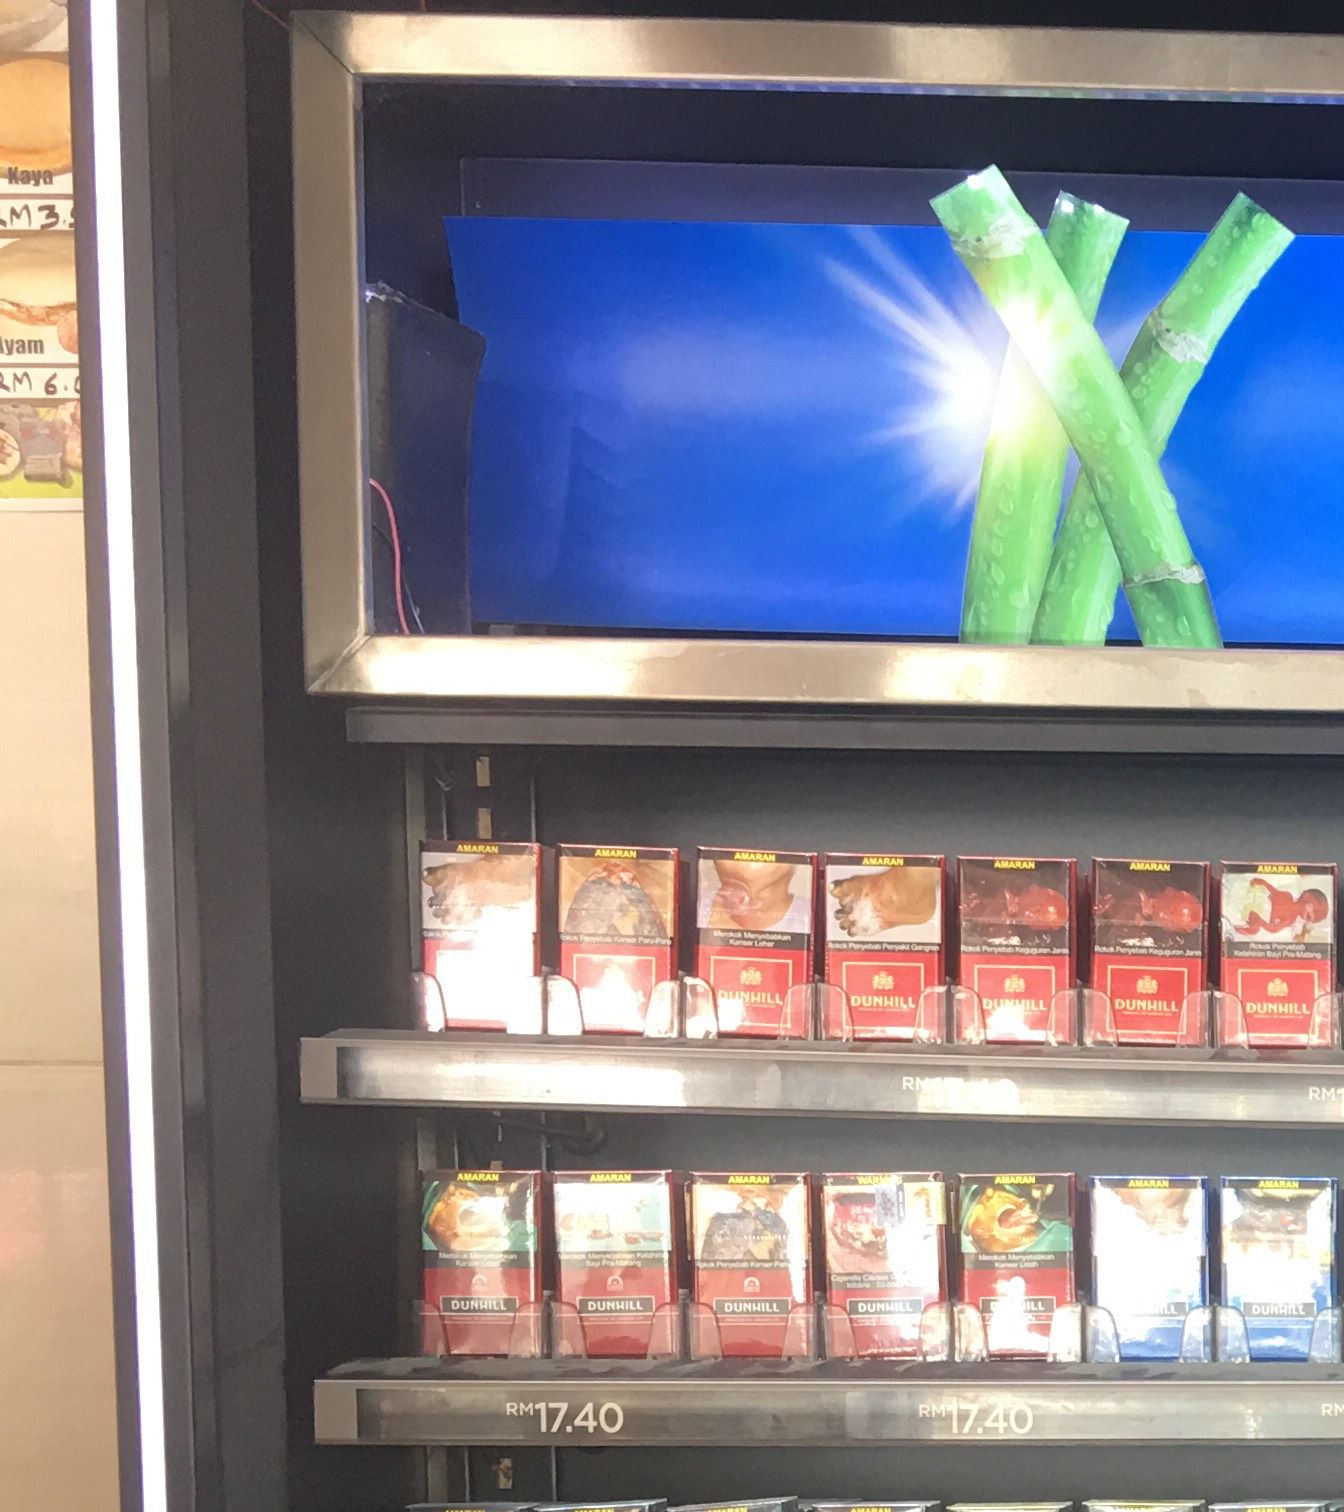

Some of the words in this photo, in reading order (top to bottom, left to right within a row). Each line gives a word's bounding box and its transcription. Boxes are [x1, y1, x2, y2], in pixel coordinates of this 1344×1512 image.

[8, 167, 53, 186] Kaya
[0, 204, 31, 227] M
[457, 844, 498, 854] AMARAN
[595, 849, 636, 858] AMARAN
[734, 852, 775, 861] AMARAN
[863, 857, 903, 865] AMARAN
[994, 860, 1035, 869] AMARAN
[1130, 863, 1170, 871] AMARAN
[1257, 865, 1297, 873] AMARAN
[851, 995, 916, 1008] DUNHILL
[983, 999, 1047, 1010] DUNHILL
[1115, 998, 1178, 1012] DUNHILL
[1247, 1003, 1310, 1015] DUNHILL
[590, 1174, 631, 1182] AMARAN
[728, 1176, 770, 1184] AMARAN
[995, 1176, 1035, 1184] AMARAN
[1129, 1180, 1169, 1188] AMARAN
[1258, 1181, 1299, 1189] AMARAN
[452, 1300, 506, 1311] DUNHILL
[588, 1300, 643, 1311] DUNHILL
[725, 1303, 780, 1312] DUNHILL
[858, 1302, 913, 1312] DUNHILL
[1253, 1306, 1305, 1315] DUNHILL
[505, 1402, 624, 1434] RM17.40
[918, 1402, 1034, 1435] RM17.40
